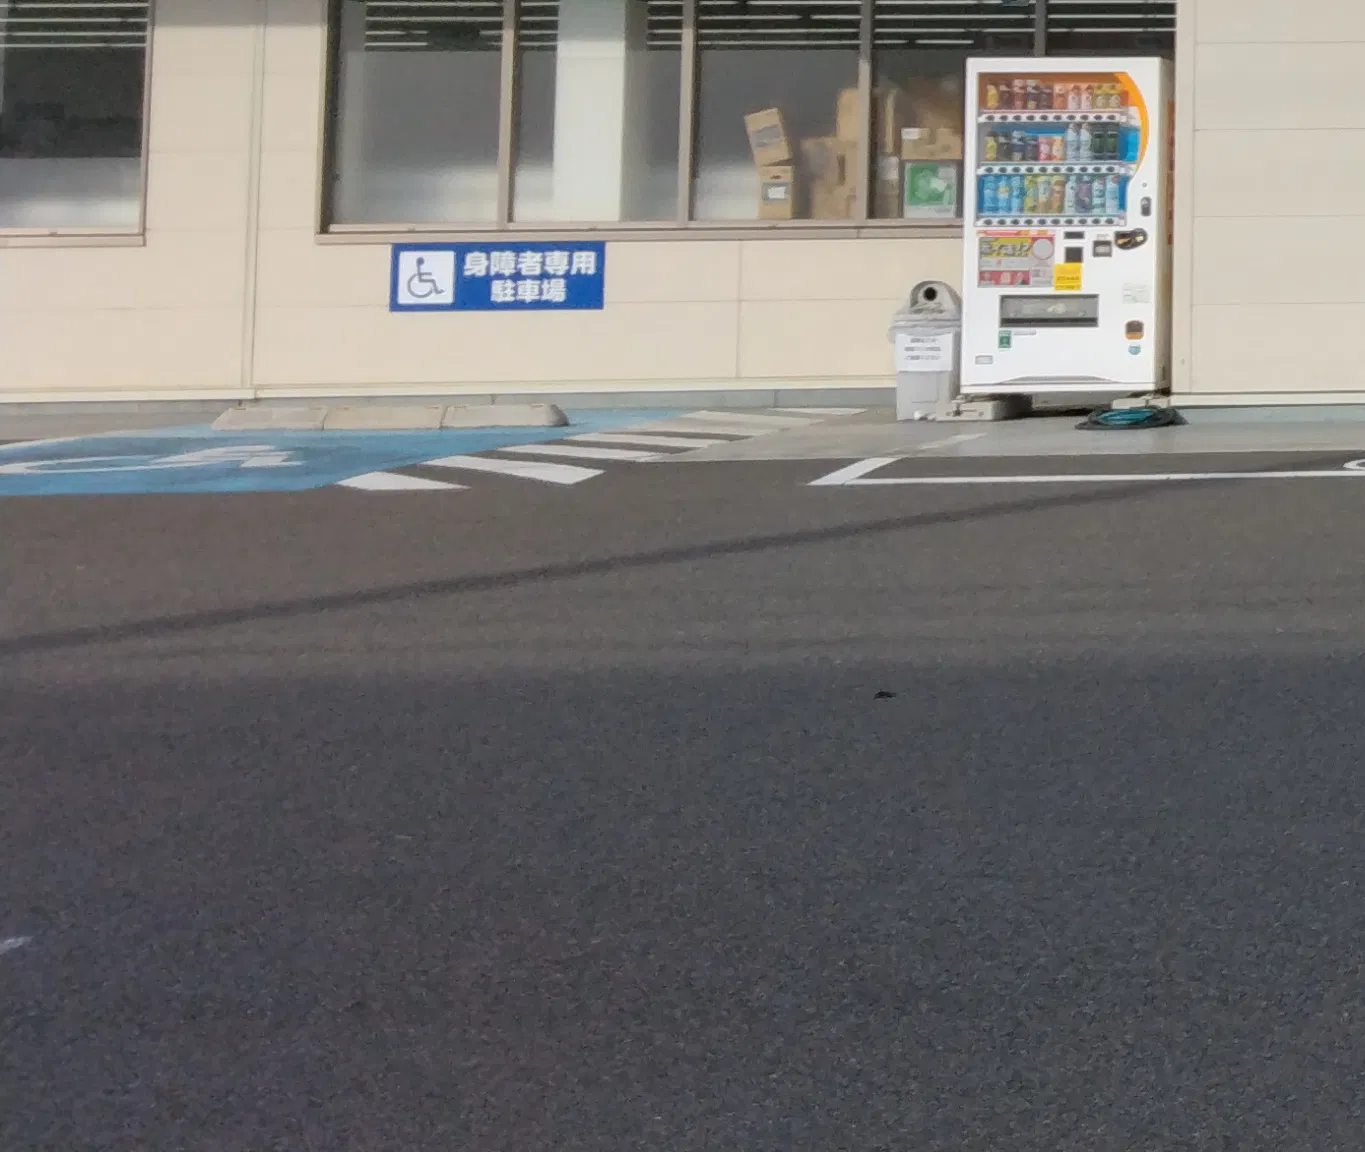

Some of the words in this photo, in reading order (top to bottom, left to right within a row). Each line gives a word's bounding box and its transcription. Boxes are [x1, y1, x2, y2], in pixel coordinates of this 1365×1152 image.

[462, 250, 597, 277] 身障者専用
[490, 278, 568, 303] 駐車場
